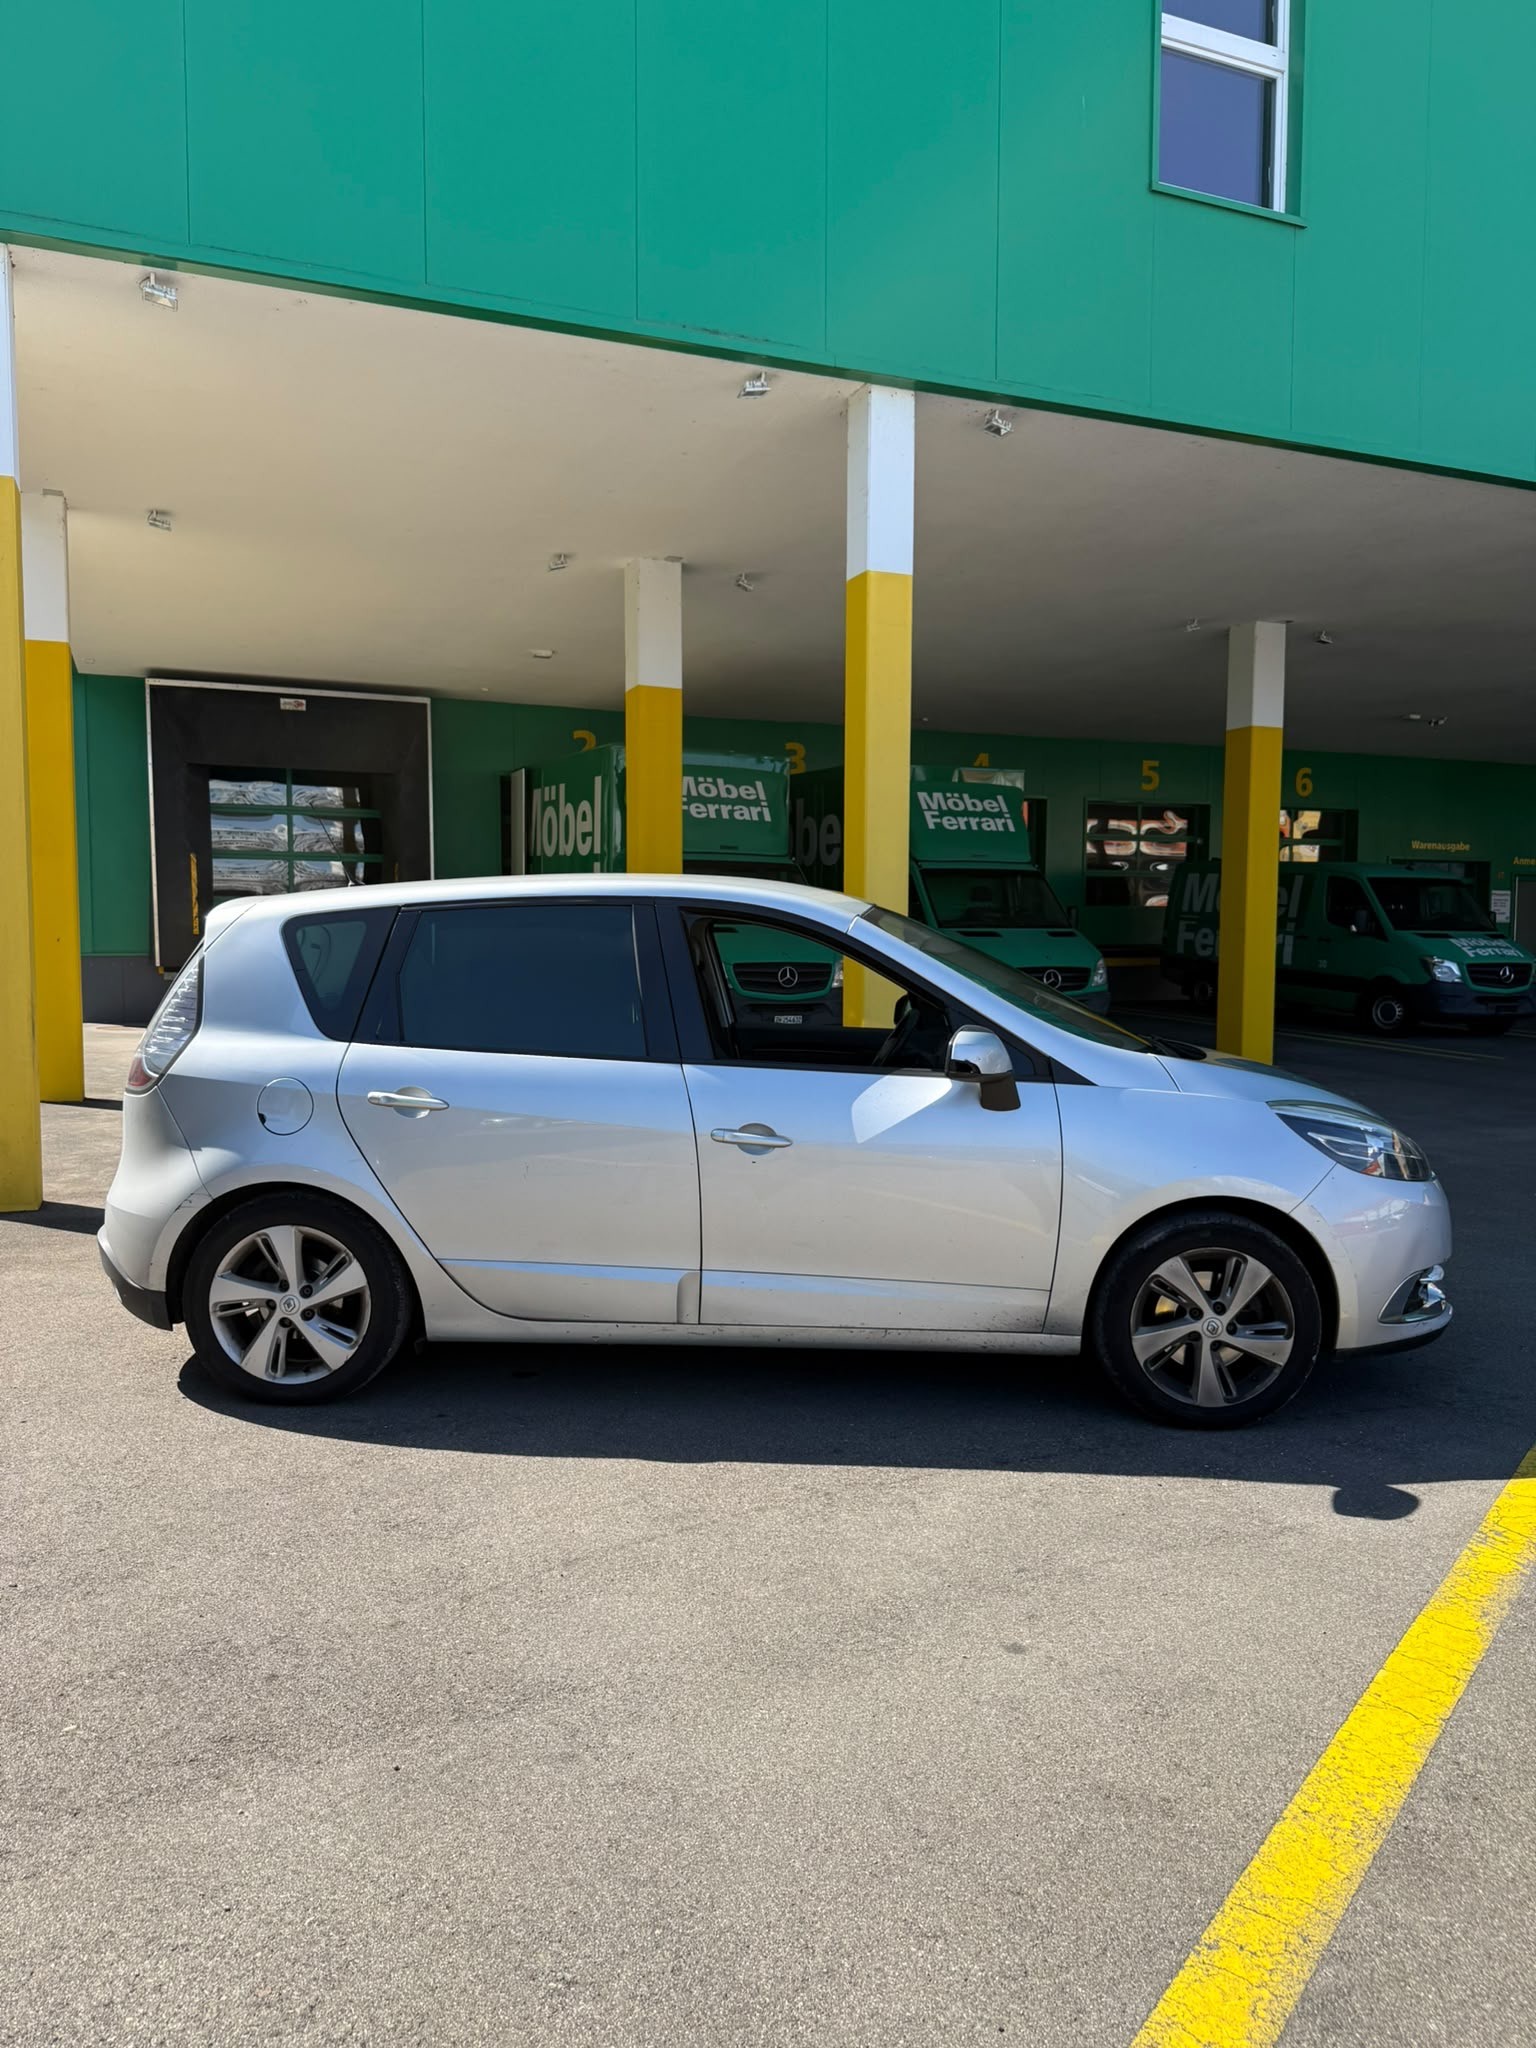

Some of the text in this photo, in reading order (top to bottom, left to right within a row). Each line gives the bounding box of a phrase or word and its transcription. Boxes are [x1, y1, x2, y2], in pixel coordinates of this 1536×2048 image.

[784, 741, 806, 775] 3
[1140, 759, 1160, 791] 5
[1295, 767, 1312, 798] 6
[682, 797, 772, 822] errari
[917, 791, 1009, 813] Möbel
[923, 811, 1016, 832] Ferrari
[1411, 839, 1471, 852] Warenausgabe
[1461, 946, 1525, 958] Ferrari
